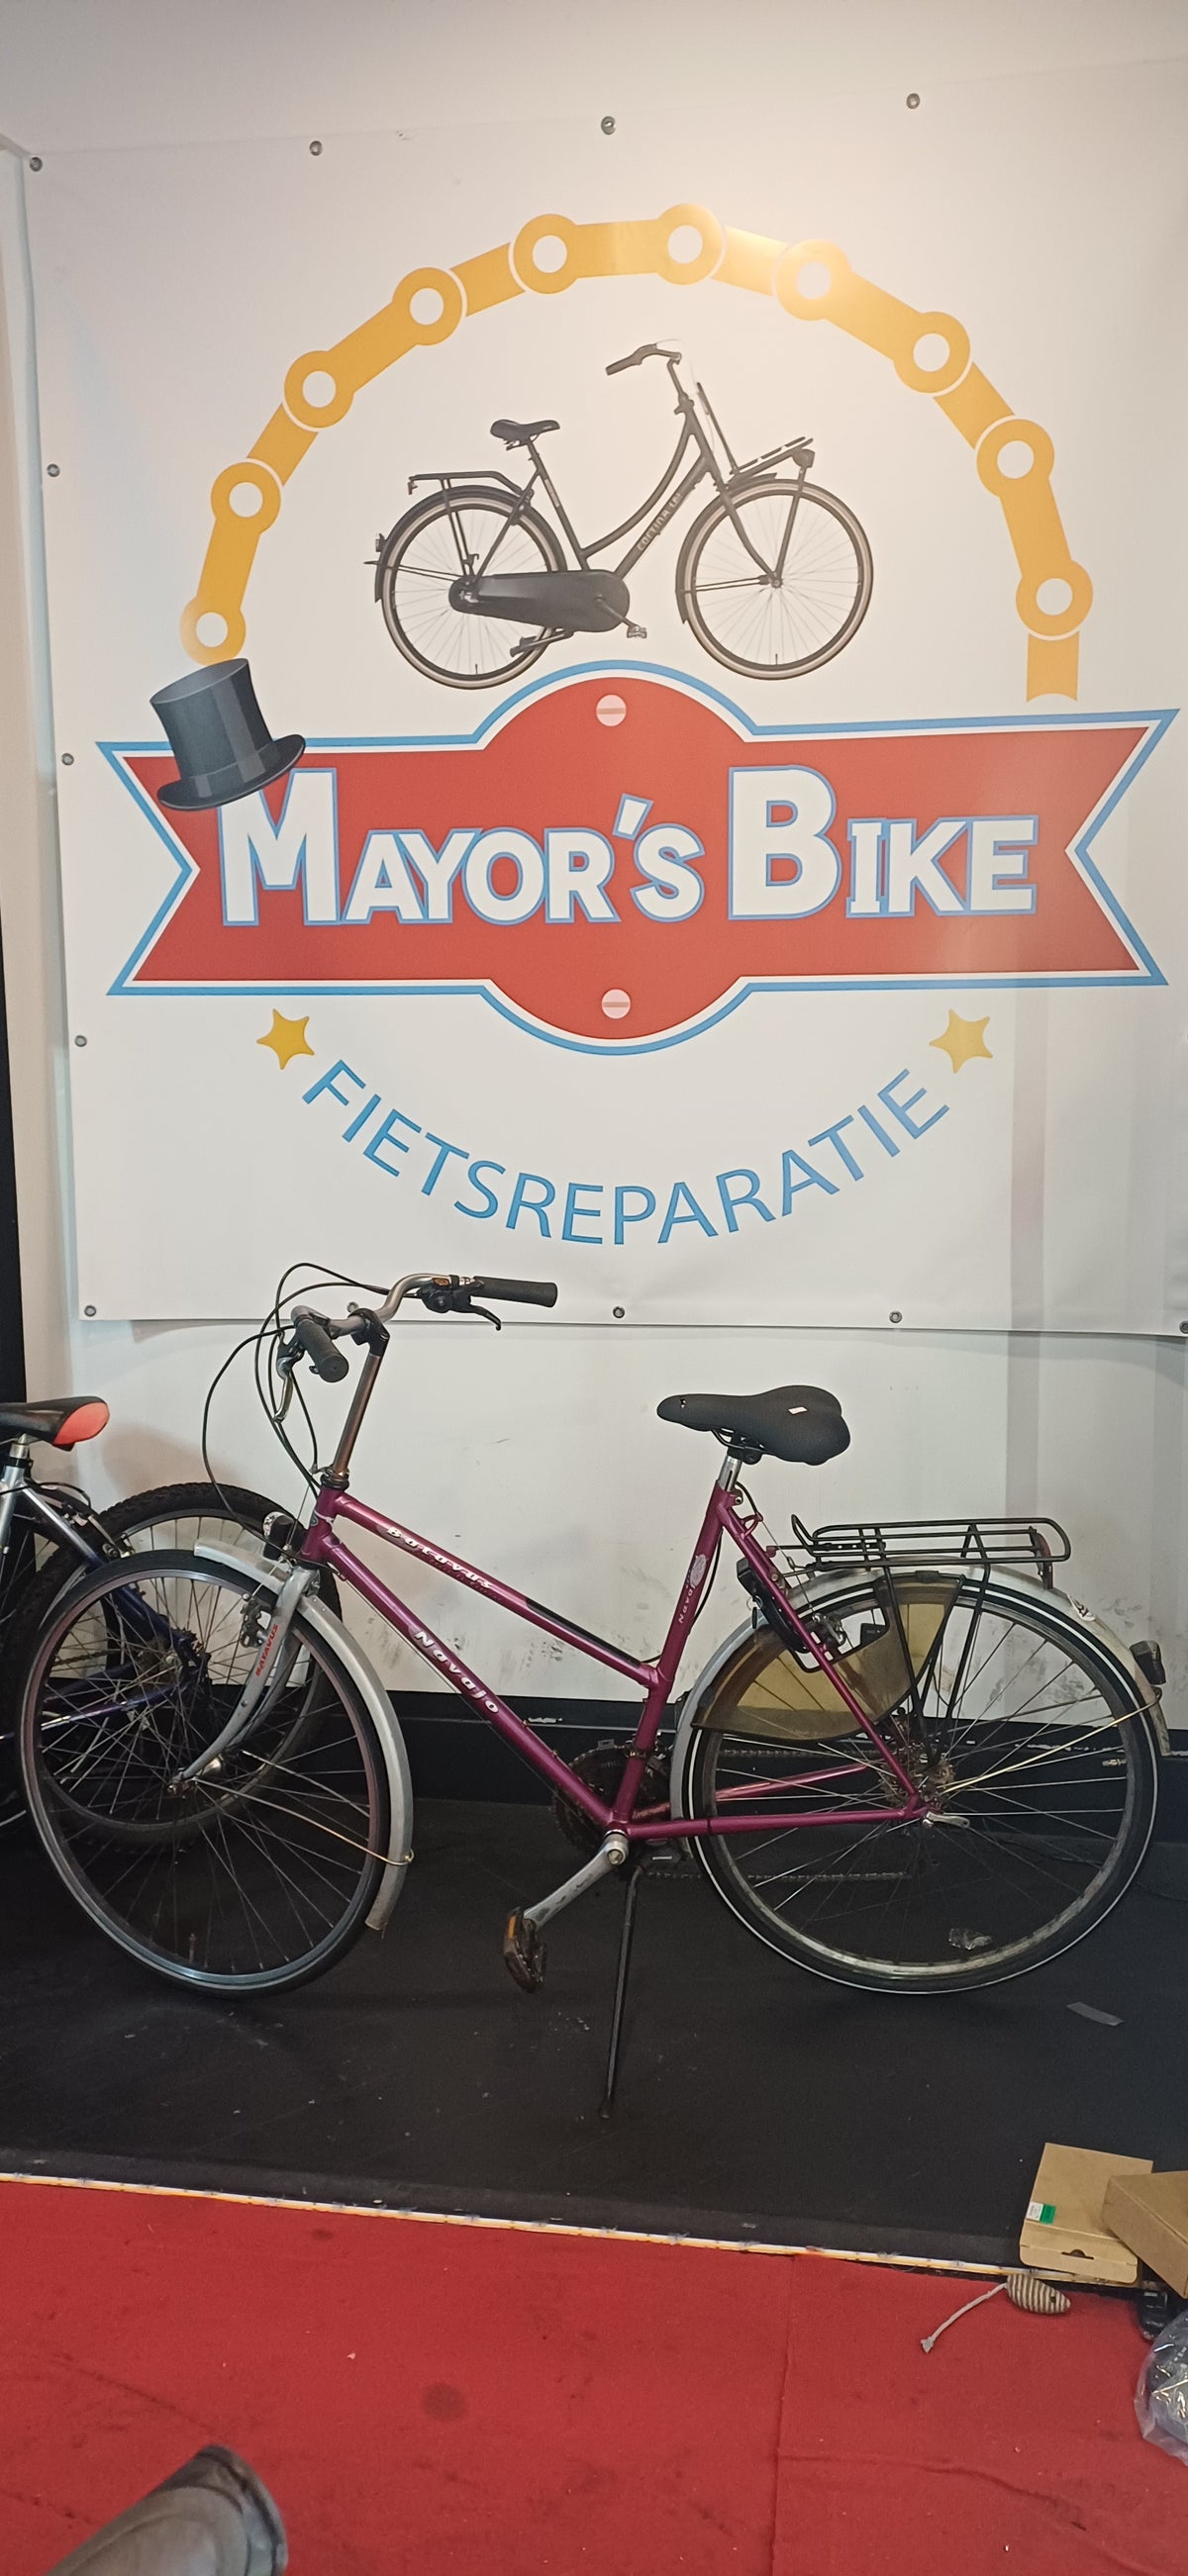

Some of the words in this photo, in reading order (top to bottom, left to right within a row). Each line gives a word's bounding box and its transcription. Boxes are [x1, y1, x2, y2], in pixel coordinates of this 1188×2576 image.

[217, 767, 705, 926] MAYOR'S
[728, 764, 1040, 920] BIKE
[302, 1059, 950, 1245] FIETSREPARATIE
[414, 1631, 500, 1714] Navajo
